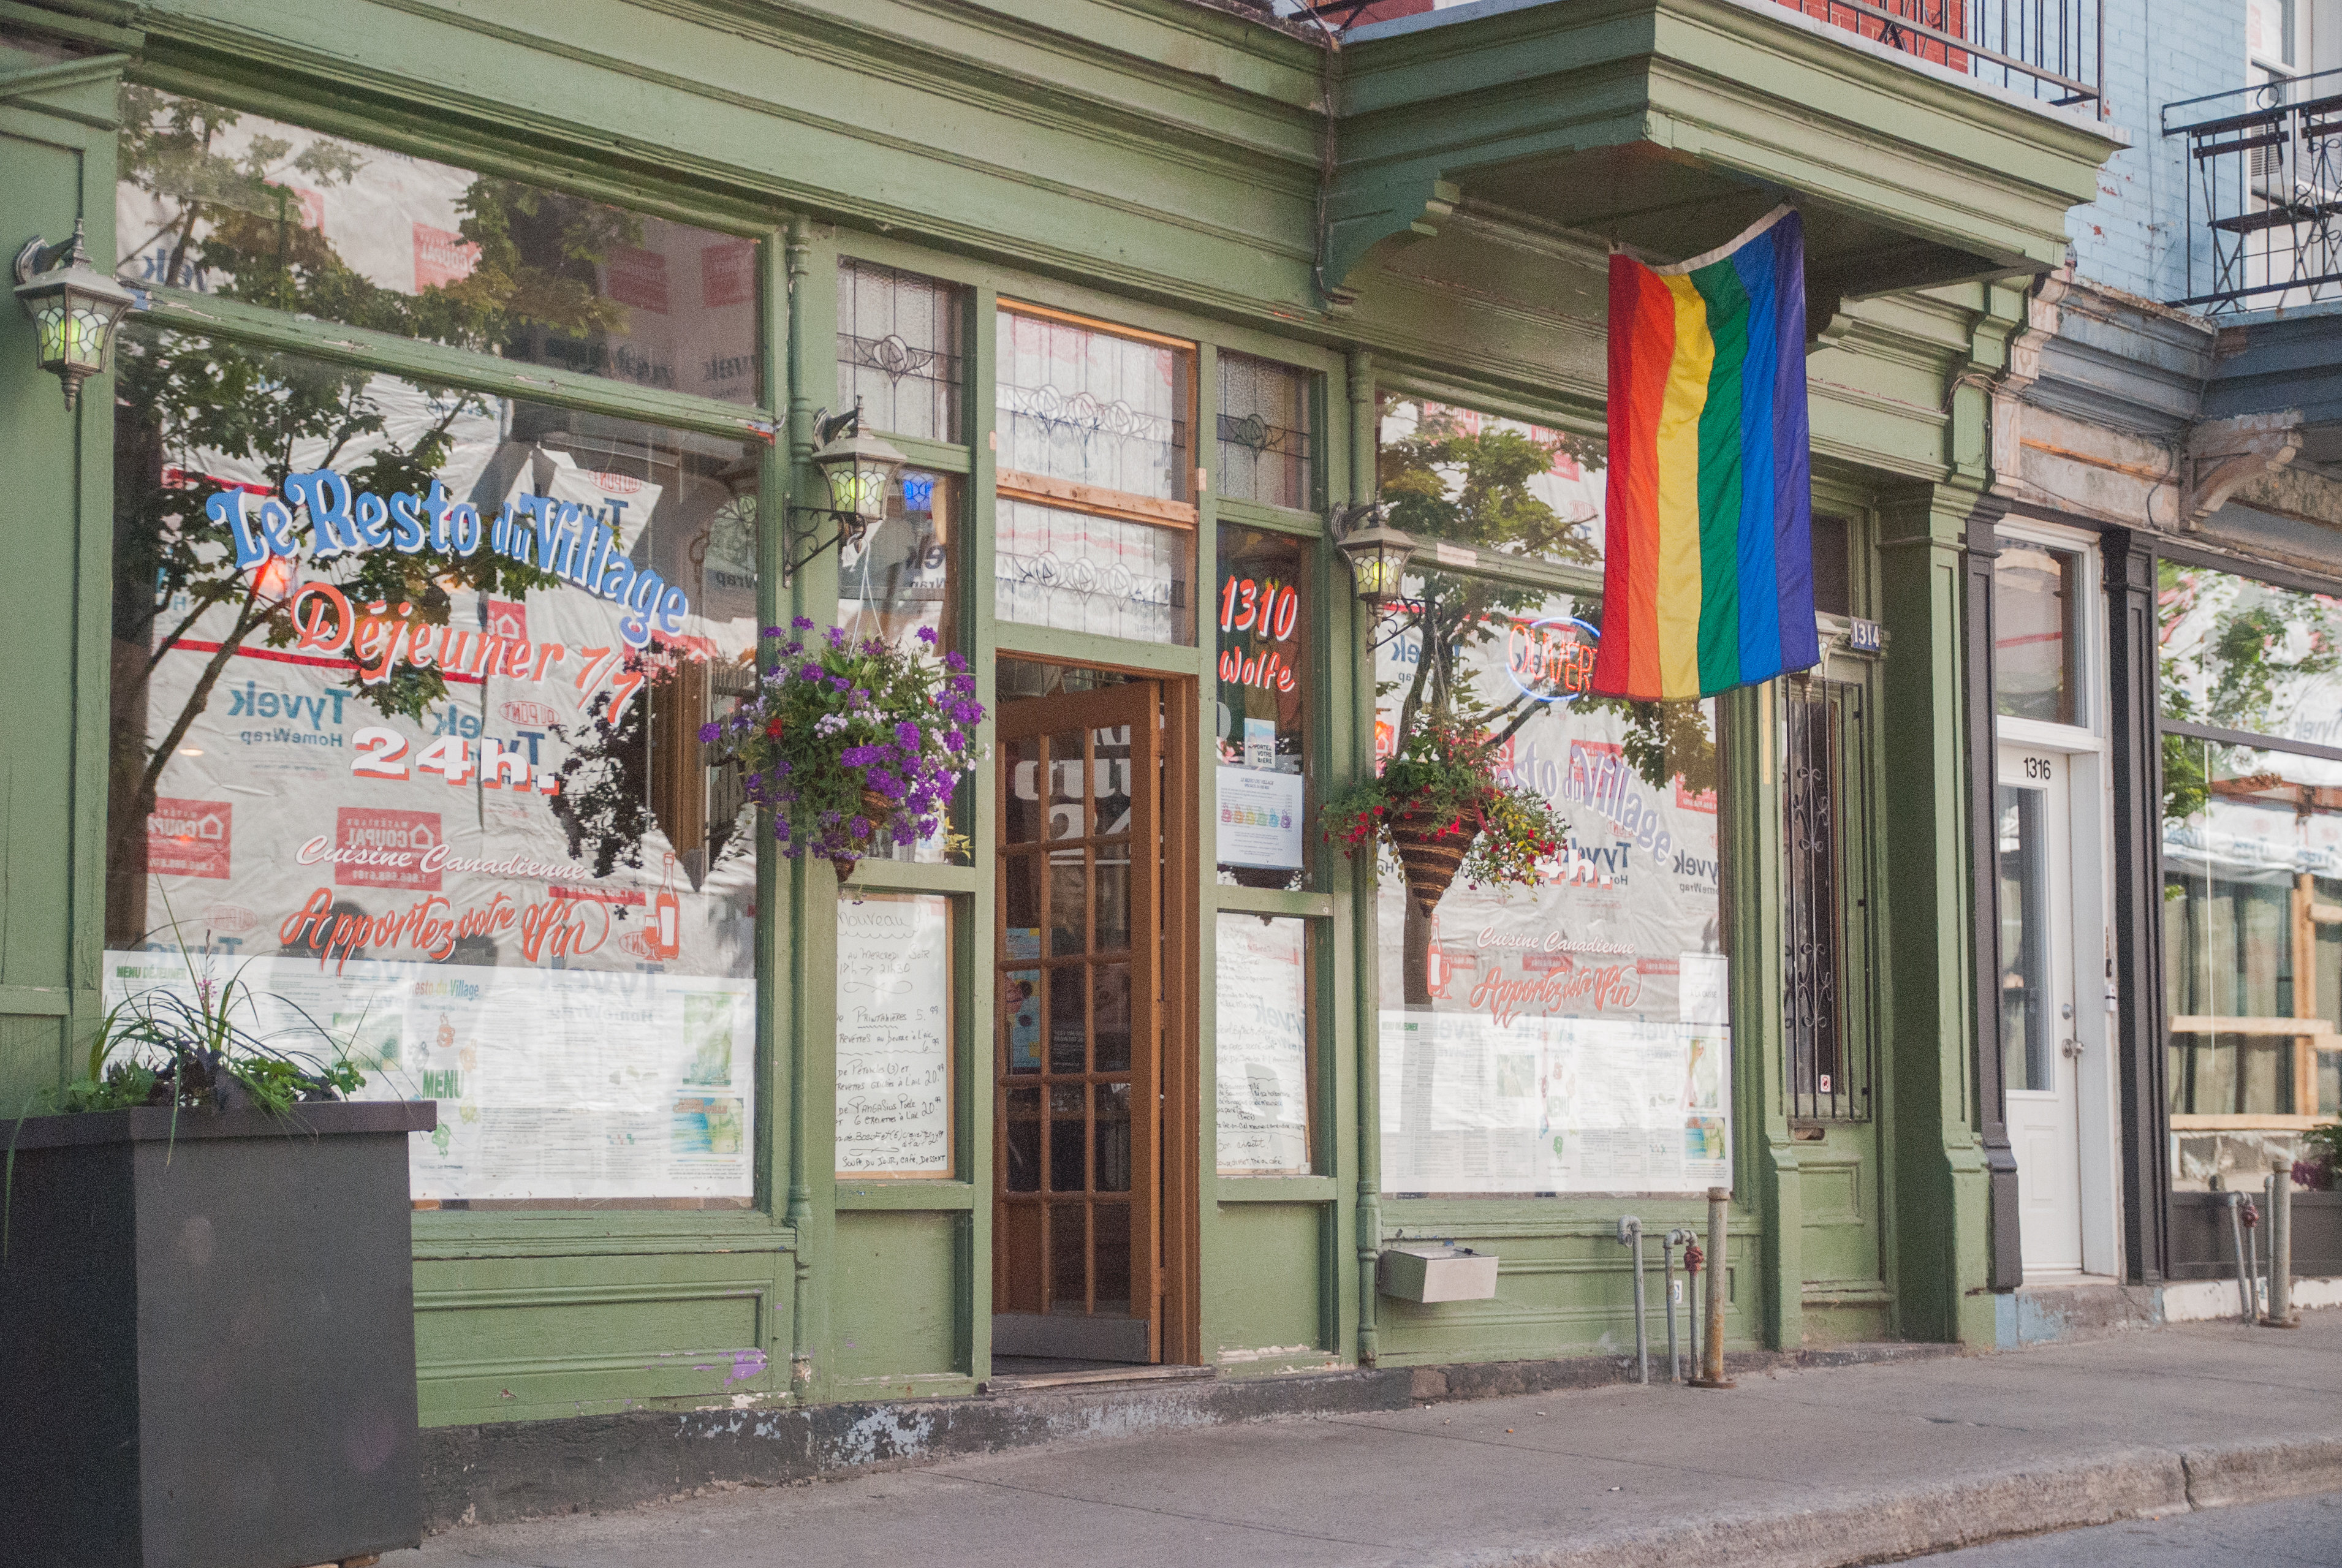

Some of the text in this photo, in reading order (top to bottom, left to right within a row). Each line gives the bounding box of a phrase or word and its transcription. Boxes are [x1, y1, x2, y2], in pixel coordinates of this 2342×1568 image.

[206, 469, 688, 648] Le Resto du Village
[1221, 575, 1298, 642] 1310
[290, 582, 564, 685] Déjeuner
[576, 646, 645, 726] 7/7
[1854, 621, 1880, 647] 1314
[1219, 646, 1295, 692] Wolfe
[350, 727, 559, 795] 24h.
[1563, 763, 1584, 803] du
[2023, 757, 2051, 780] 1316
[1570, 744, 1673, 865] Village
[296, 835, 412, 868] Cuisine
[420, 843, 590, 879] Canadienne
[280, 887, 612, 977] Apportez votre Vin
[1476, 925, 1636, 955] Cuisine Canadienne
[450, 979, 480, 1001] Village
[1470, 966, 1569, 1028] Apportez
[1593, 964, 1643, 1011] Vin
[423, 1069, 464, 1099] MENU
[1547, 1096, 1571, 1118] MENU
